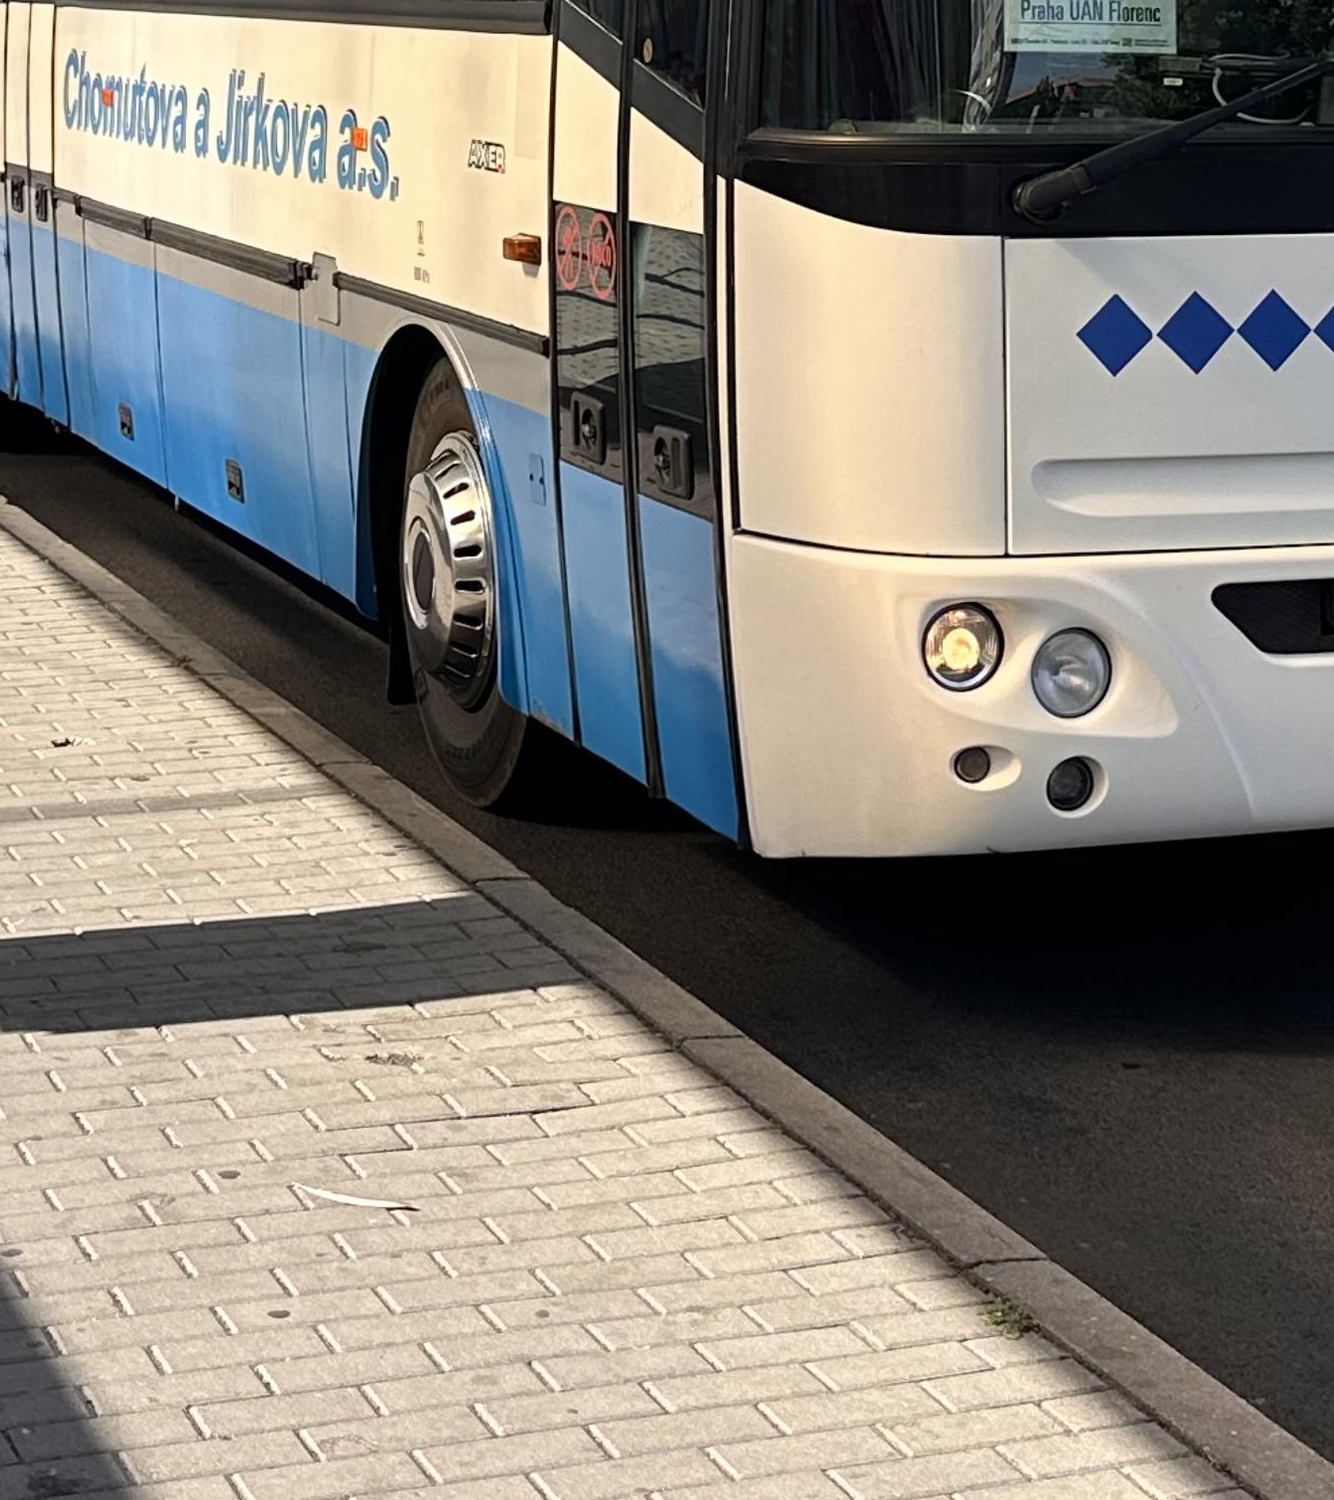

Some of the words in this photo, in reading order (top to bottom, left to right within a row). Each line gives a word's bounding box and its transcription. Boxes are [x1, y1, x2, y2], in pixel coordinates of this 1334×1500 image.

[1020, 0, 1064, 20] Praha
[1108, 0, 1161, 22] Florenc
[63, 48, 188, 153] Chomutova
[194, 87, 211, 158] a
[217, 67, 328, 184] Jirkova
[337, 108, 400, 201] a.s.
[468, 138, 506, 174] AXER
